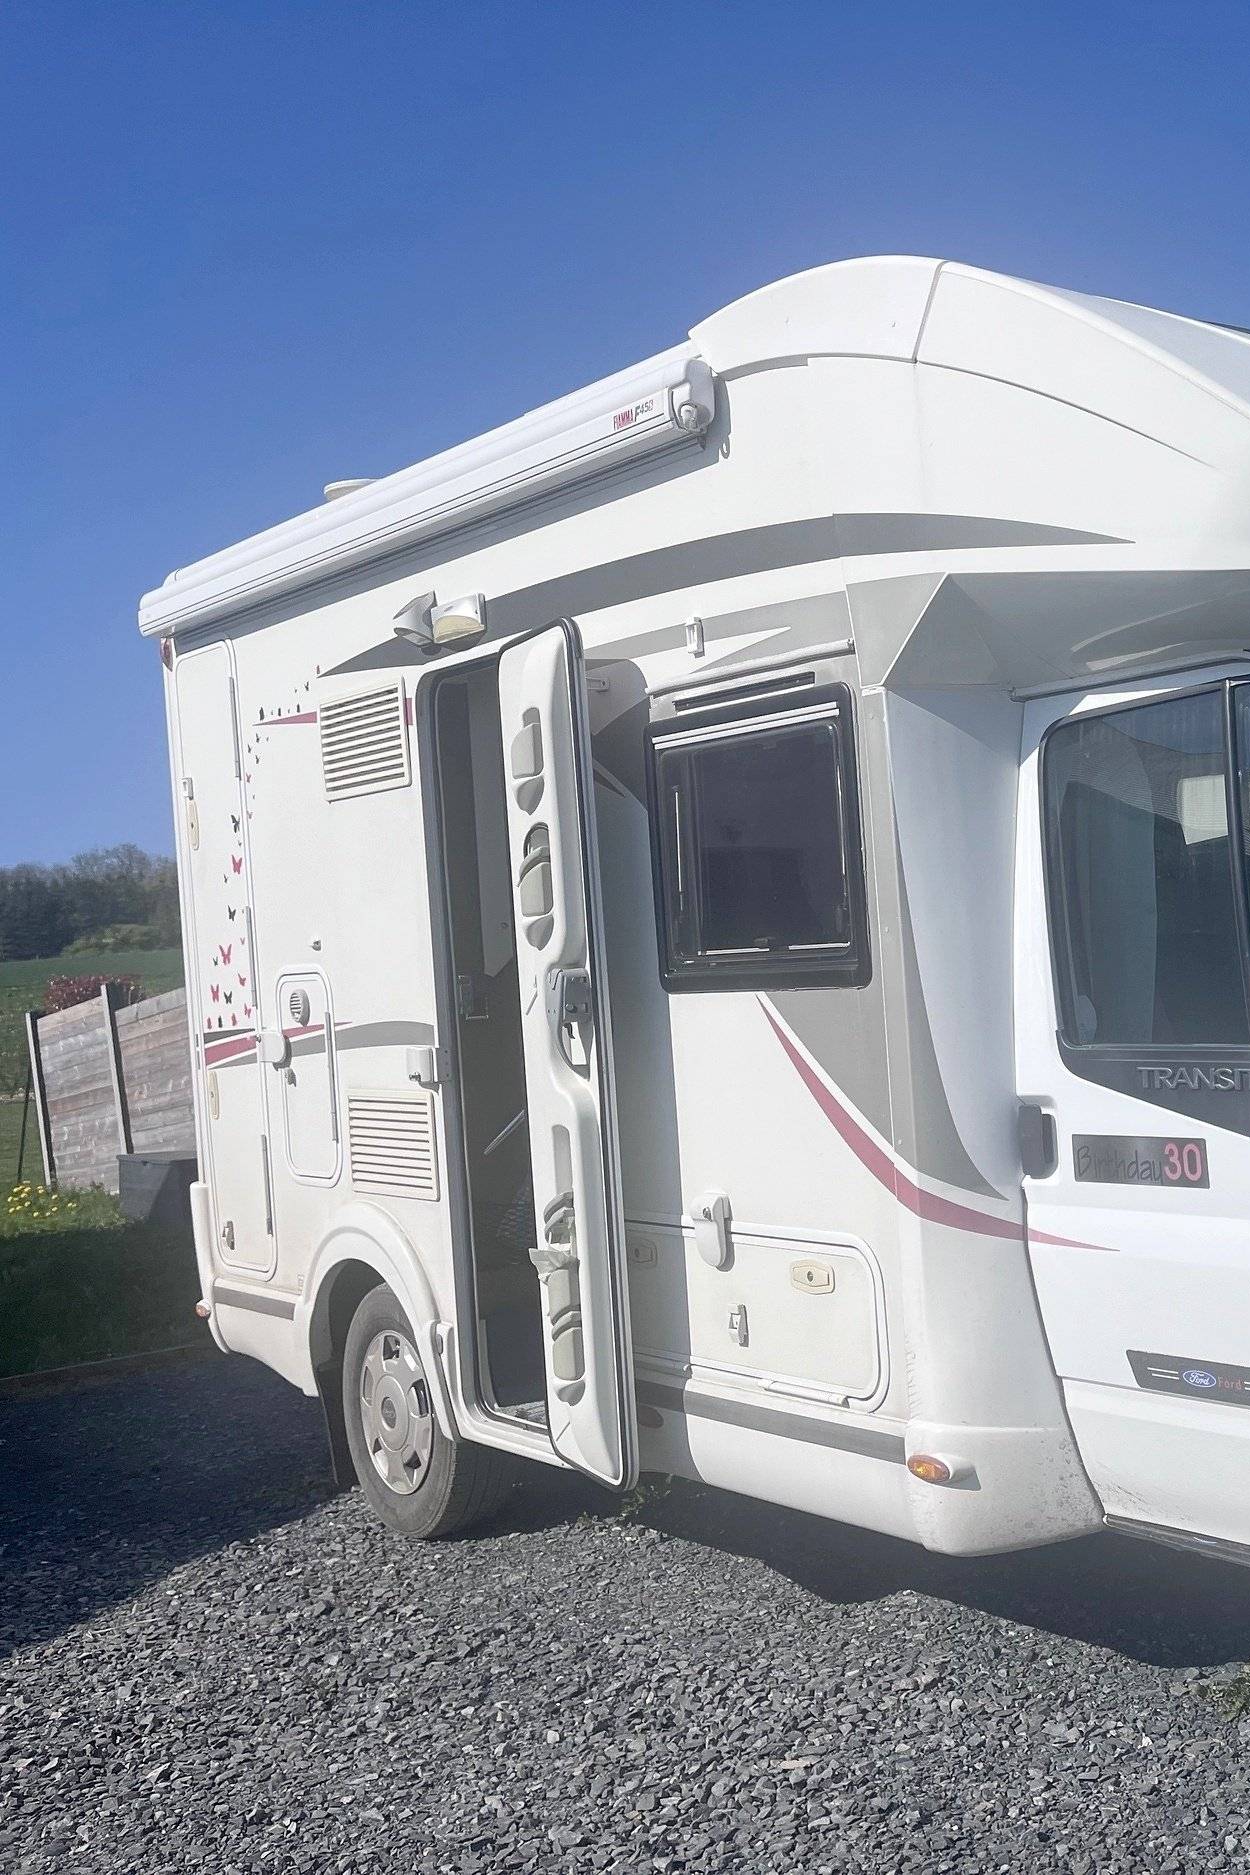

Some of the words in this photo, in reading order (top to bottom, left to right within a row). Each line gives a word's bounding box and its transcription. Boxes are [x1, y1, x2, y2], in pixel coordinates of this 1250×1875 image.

[1075, 1145, 1164, 1184] Birthday
[1163, 1142, 1202, 1181] 30
[1189, 1372, 1210, 1386] Ford
